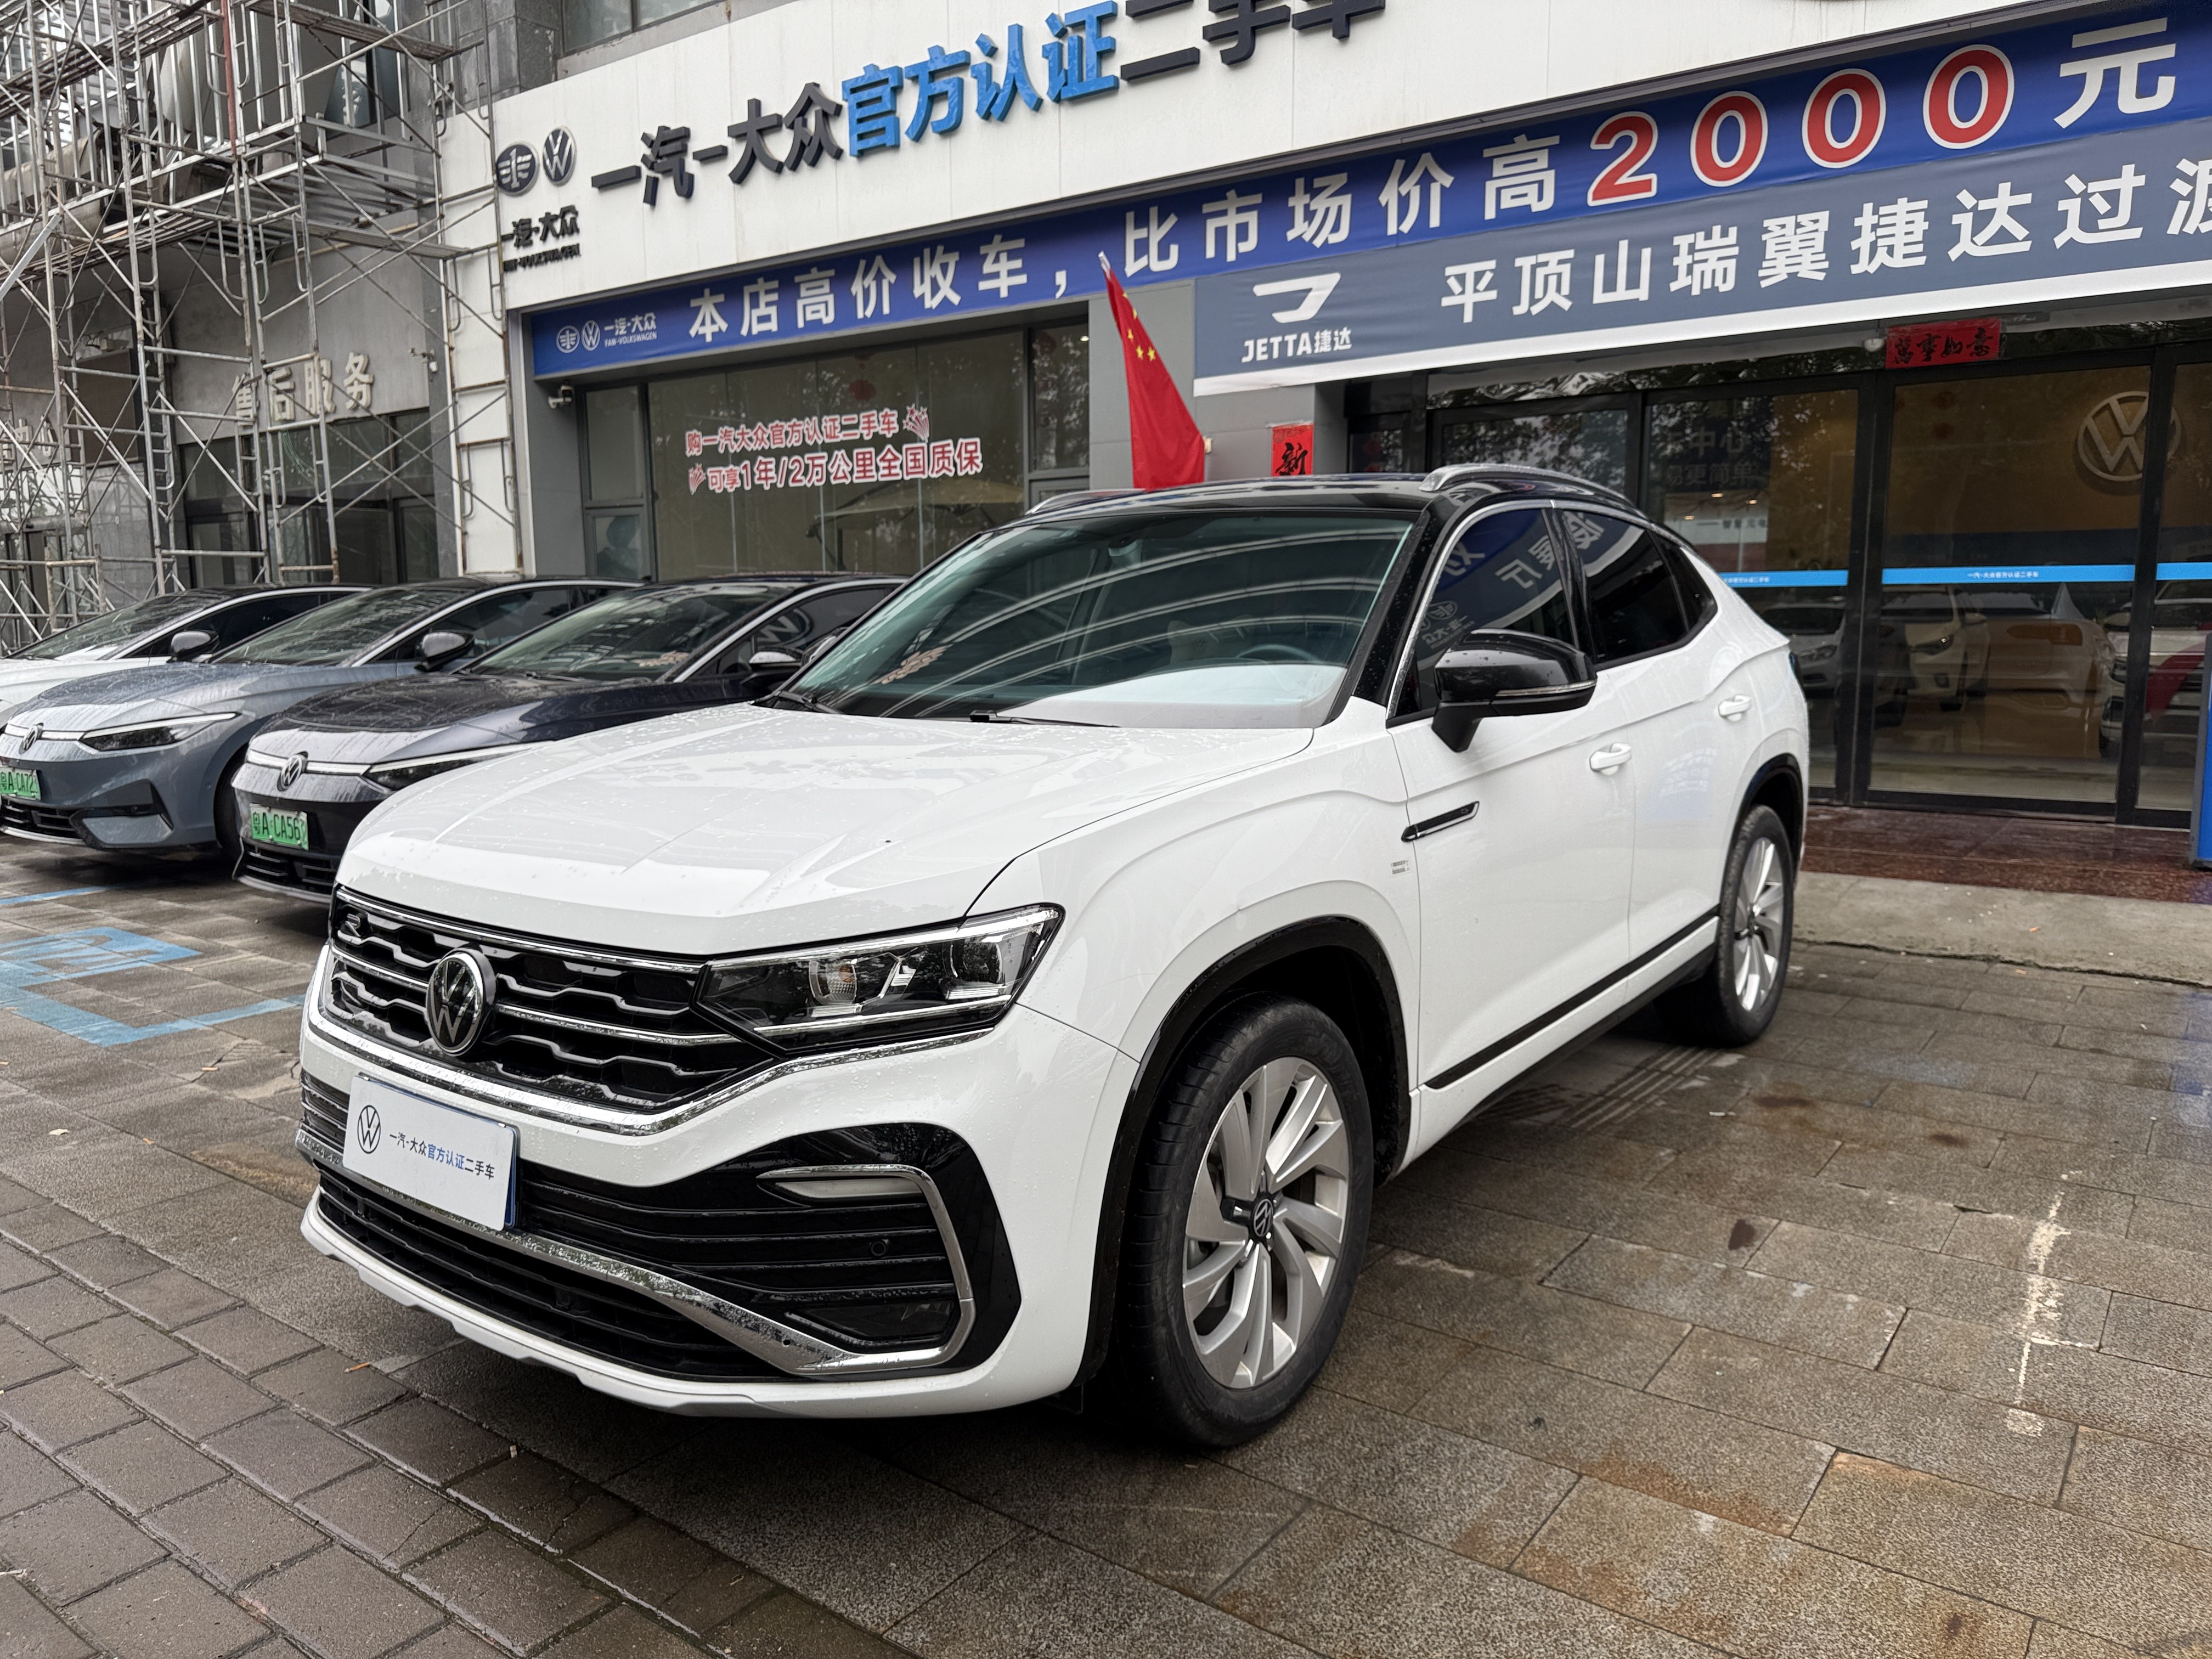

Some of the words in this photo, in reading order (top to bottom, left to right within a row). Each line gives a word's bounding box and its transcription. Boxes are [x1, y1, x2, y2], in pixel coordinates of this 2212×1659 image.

[604, 331, 658, 348] FAW-VOLKSWAGEN
[685, 408, 900, 458] 购一汽大众官方认证二手车
[707, 437, 984, 494] 可享1年/2万公里全国质保
[389, 1131, 495, 1181] 一汽-大众官方认证二手车
